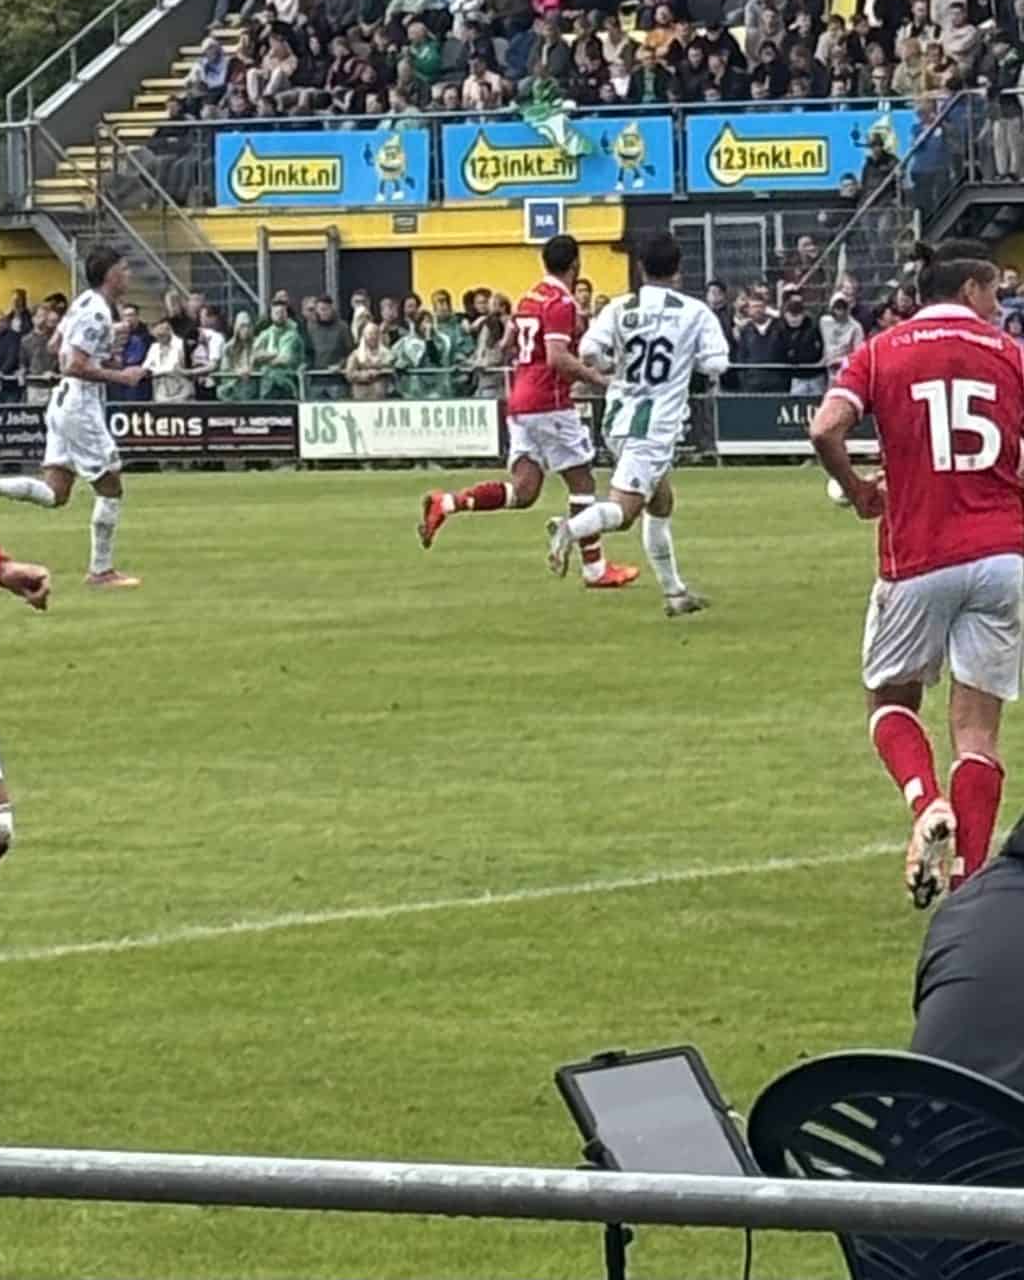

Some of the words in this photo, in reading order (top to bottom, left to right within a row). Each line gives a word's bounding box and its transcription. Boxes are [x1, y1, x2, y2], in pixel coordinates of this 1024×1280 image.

[712, 144, 823, 171] 123inkt.nl
[237, 161, 337, 187] 123inkt.nl
[626, 335, 674, 386] 26
[110, 411, 203, 437] Ottens
[305, 406, 338, 444] JS
[374, 407, 411, 428] JAN
[910, 378, 1002, 472] 15
